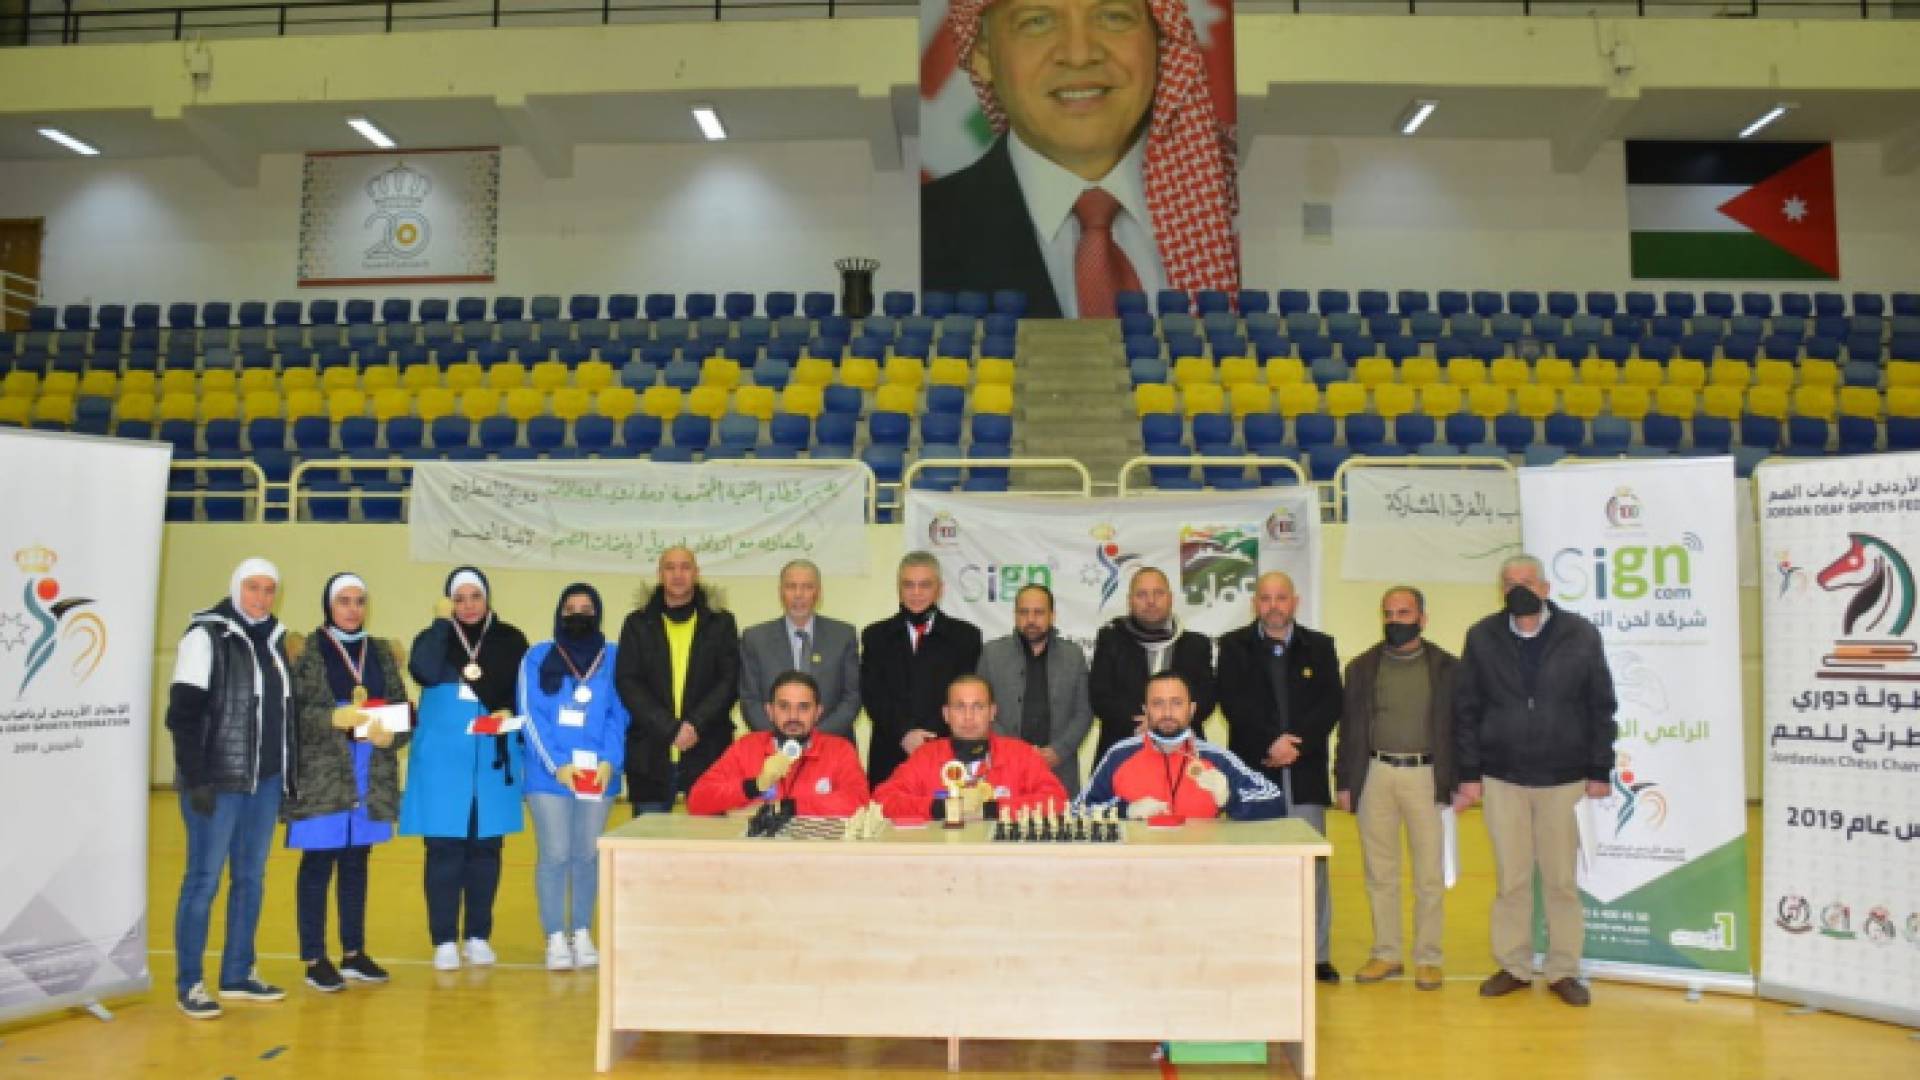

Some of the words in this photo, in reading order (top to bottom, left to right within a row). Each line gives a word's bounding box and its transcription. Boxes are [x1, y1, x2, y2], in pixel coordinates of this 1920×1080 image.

[1655, 609, 1708, 632] شركة
[1855, 686, 1920, 714] طولة
[1852, 724, 1920, 753] طرنج
[1787, 806, 1844, 830] 2019
